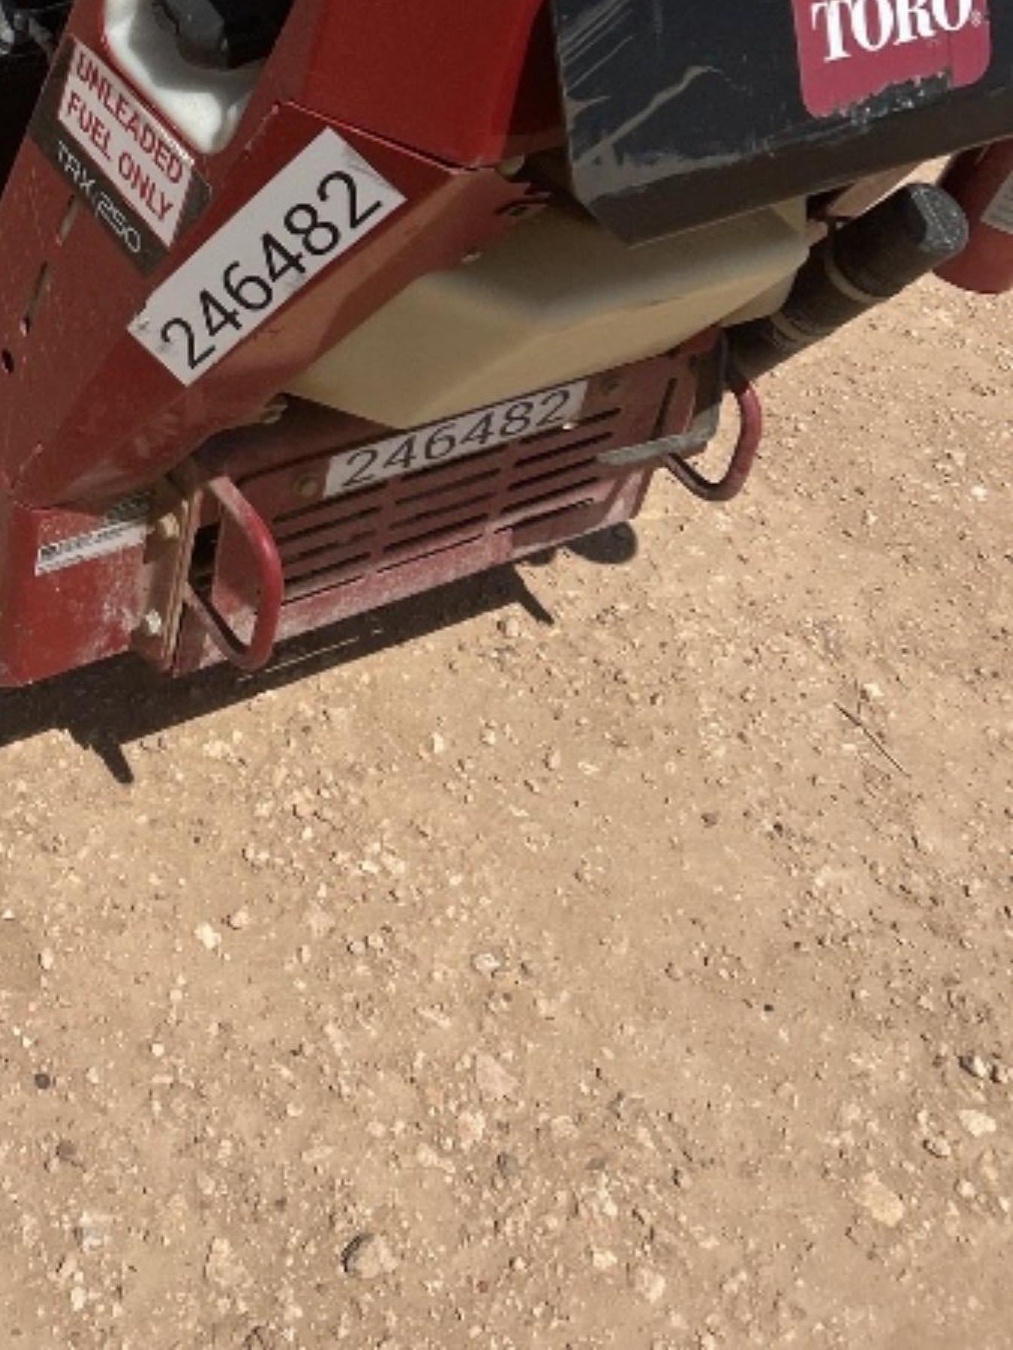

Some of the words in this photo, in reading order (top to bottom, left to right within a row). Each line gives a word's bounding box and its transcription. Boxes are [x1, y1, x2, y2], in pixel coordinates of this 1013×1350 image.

[67, 90, 112, 161] FUEL
[118, 152, 174, 221] ONLY
[77, 52, 183, 184] UNLEADED
[160, 170, 383, 370] 246482
[342, 390, 570, 486] 246482
